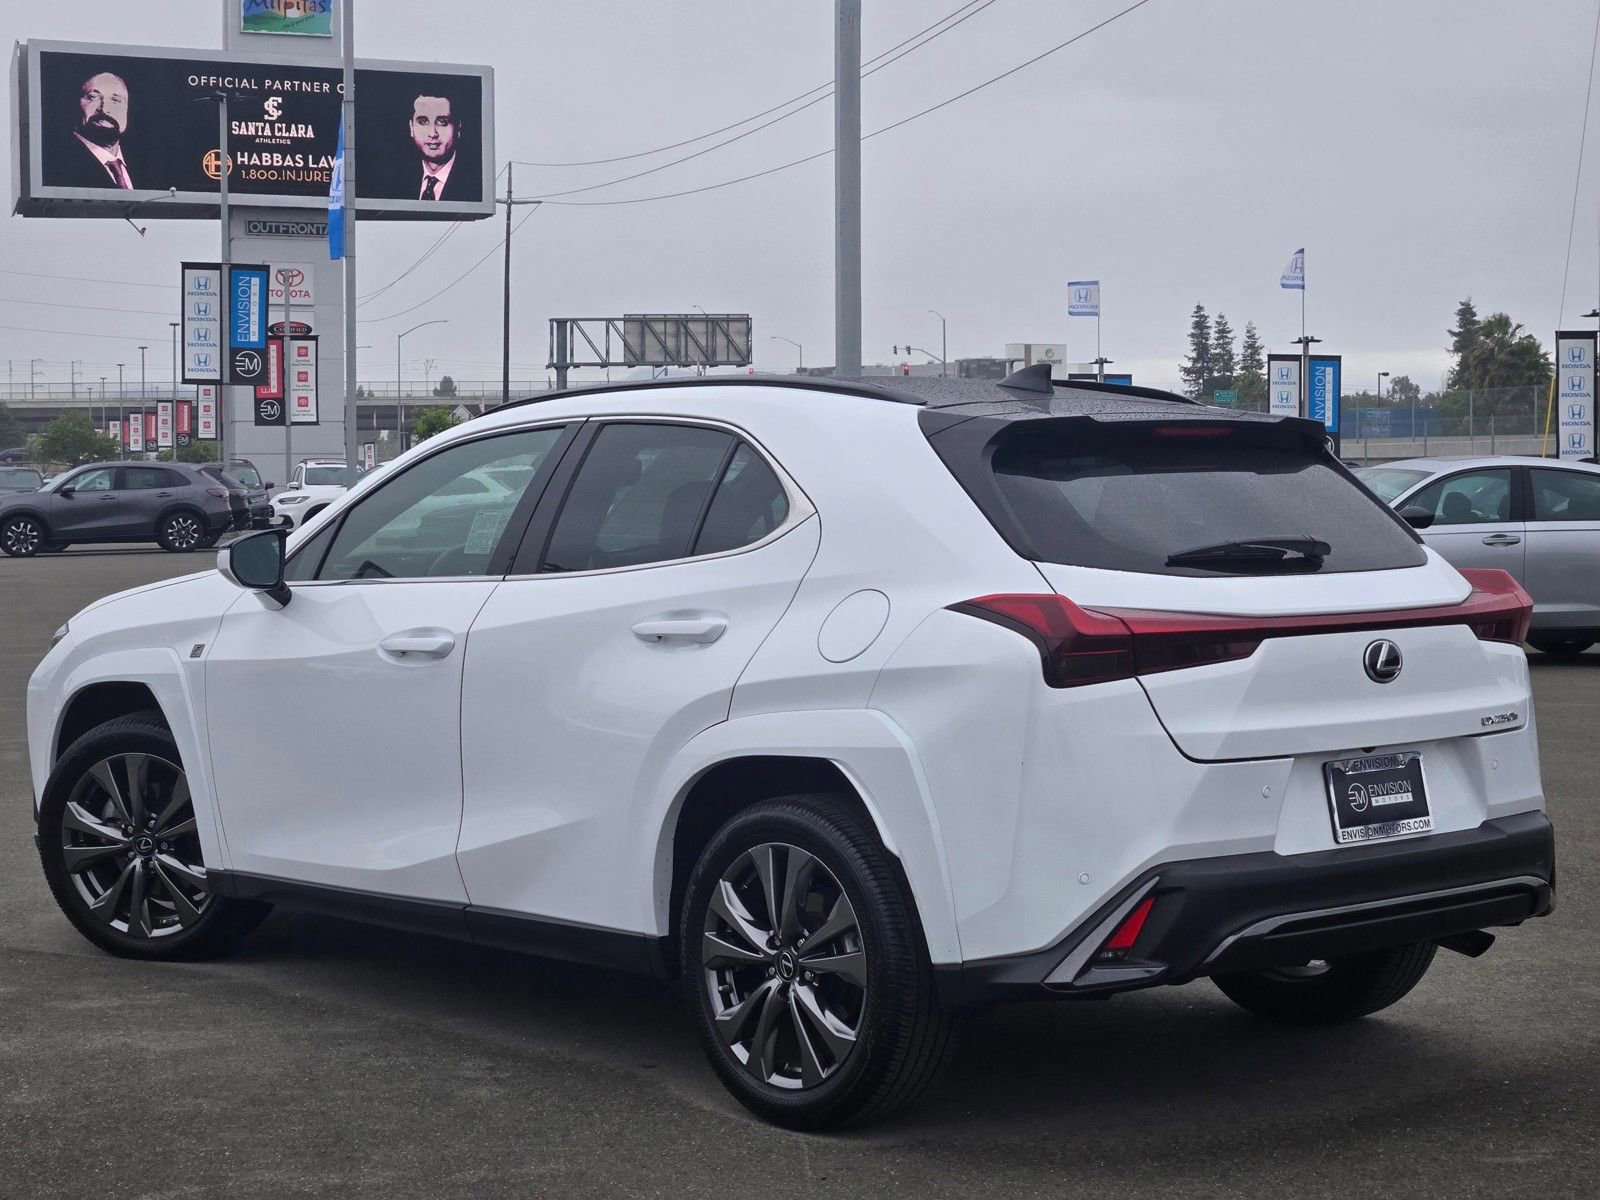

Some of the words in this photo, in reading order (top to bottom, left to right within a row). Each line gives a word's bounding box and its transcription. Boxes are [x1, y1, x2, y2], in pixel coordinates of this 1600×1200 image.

[187, 75, 258, 89] OFFICIAL
[265, 79, 330, 93] PARTNER
[231, 121, 271, 136] SANTA
[274, 123, 315, 138] CLARA
[237, 152, 304, 167] HABBAS
[241, 169, 330, 182] 1.800.INJURE
[269, 289, 311, 298] TOOTA
[238, 276, 250, 341] ENVISION
[1353, 756, 1398, 771] ENVISION
[1368, 780, 1412, 797] ENVISION
[1374, 794, 1410, 804] MOTORS
[1341, 818, 1431, 840] ENVISIONMOTORS.COM
